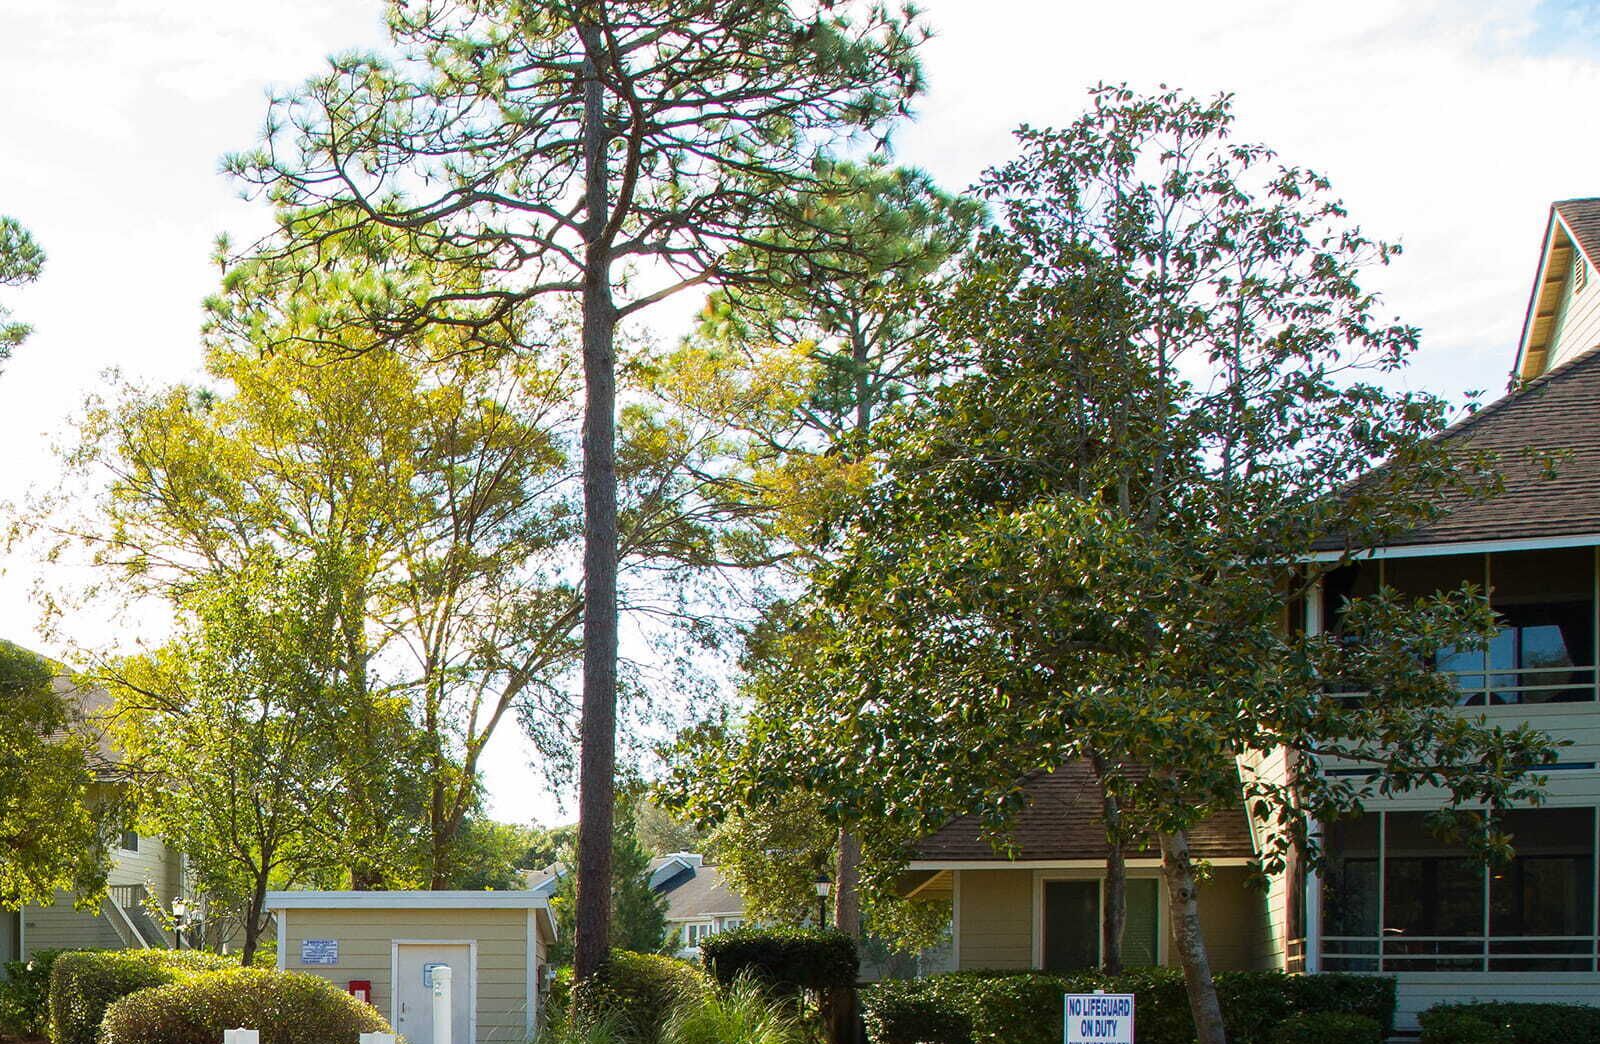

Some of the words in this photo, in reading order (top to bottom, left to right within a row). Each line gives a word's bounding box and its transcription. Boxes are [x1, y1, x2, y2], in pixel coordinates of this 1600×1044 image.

[1069, 999, 1081, 1016] NO
[1083, 998, 1130, 1016] LIFEGUARD
[1081, 1020, 1093, 1037] ON
[1095, 1019, 1118, 1037] DUTY
